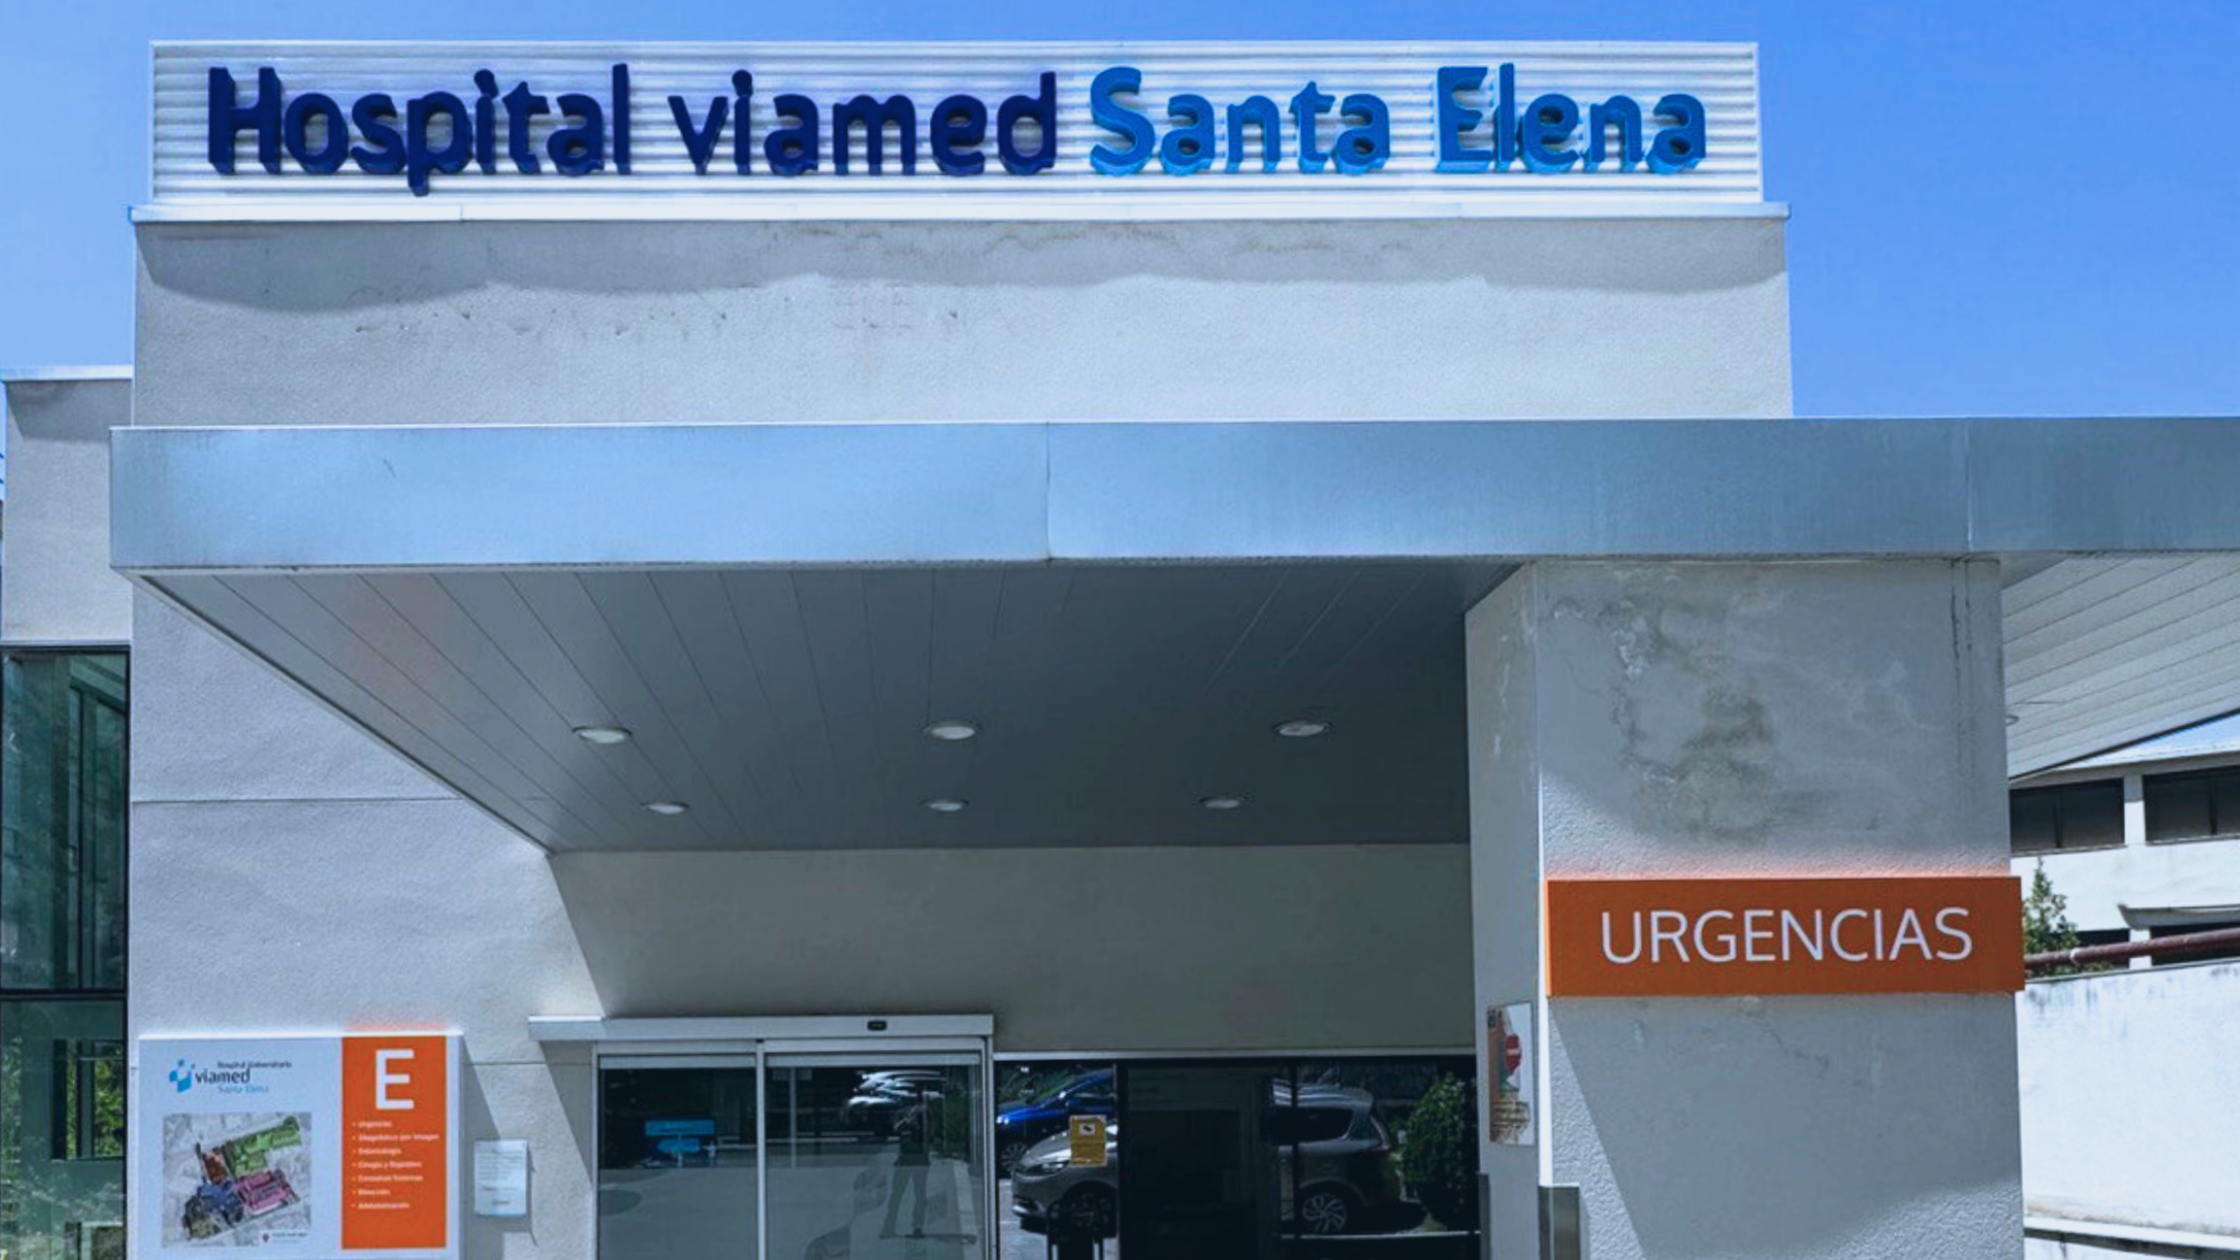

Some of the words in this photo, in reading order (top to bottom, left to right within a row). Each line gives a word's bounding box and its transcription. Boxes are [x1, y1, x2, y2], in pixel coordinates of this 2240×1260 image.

[208, 63, 631, 197] Hospital
[667, 69, 1057, 177] viamed
[1089, 66, 1392, 176] Santa
[1434, 62, 1708, 176] Elena
[1602, 907, 1973, 964] URGENCIAS
[195, 1067, 251, 1084] viamed
[375, 1048, 415, 1110] E
